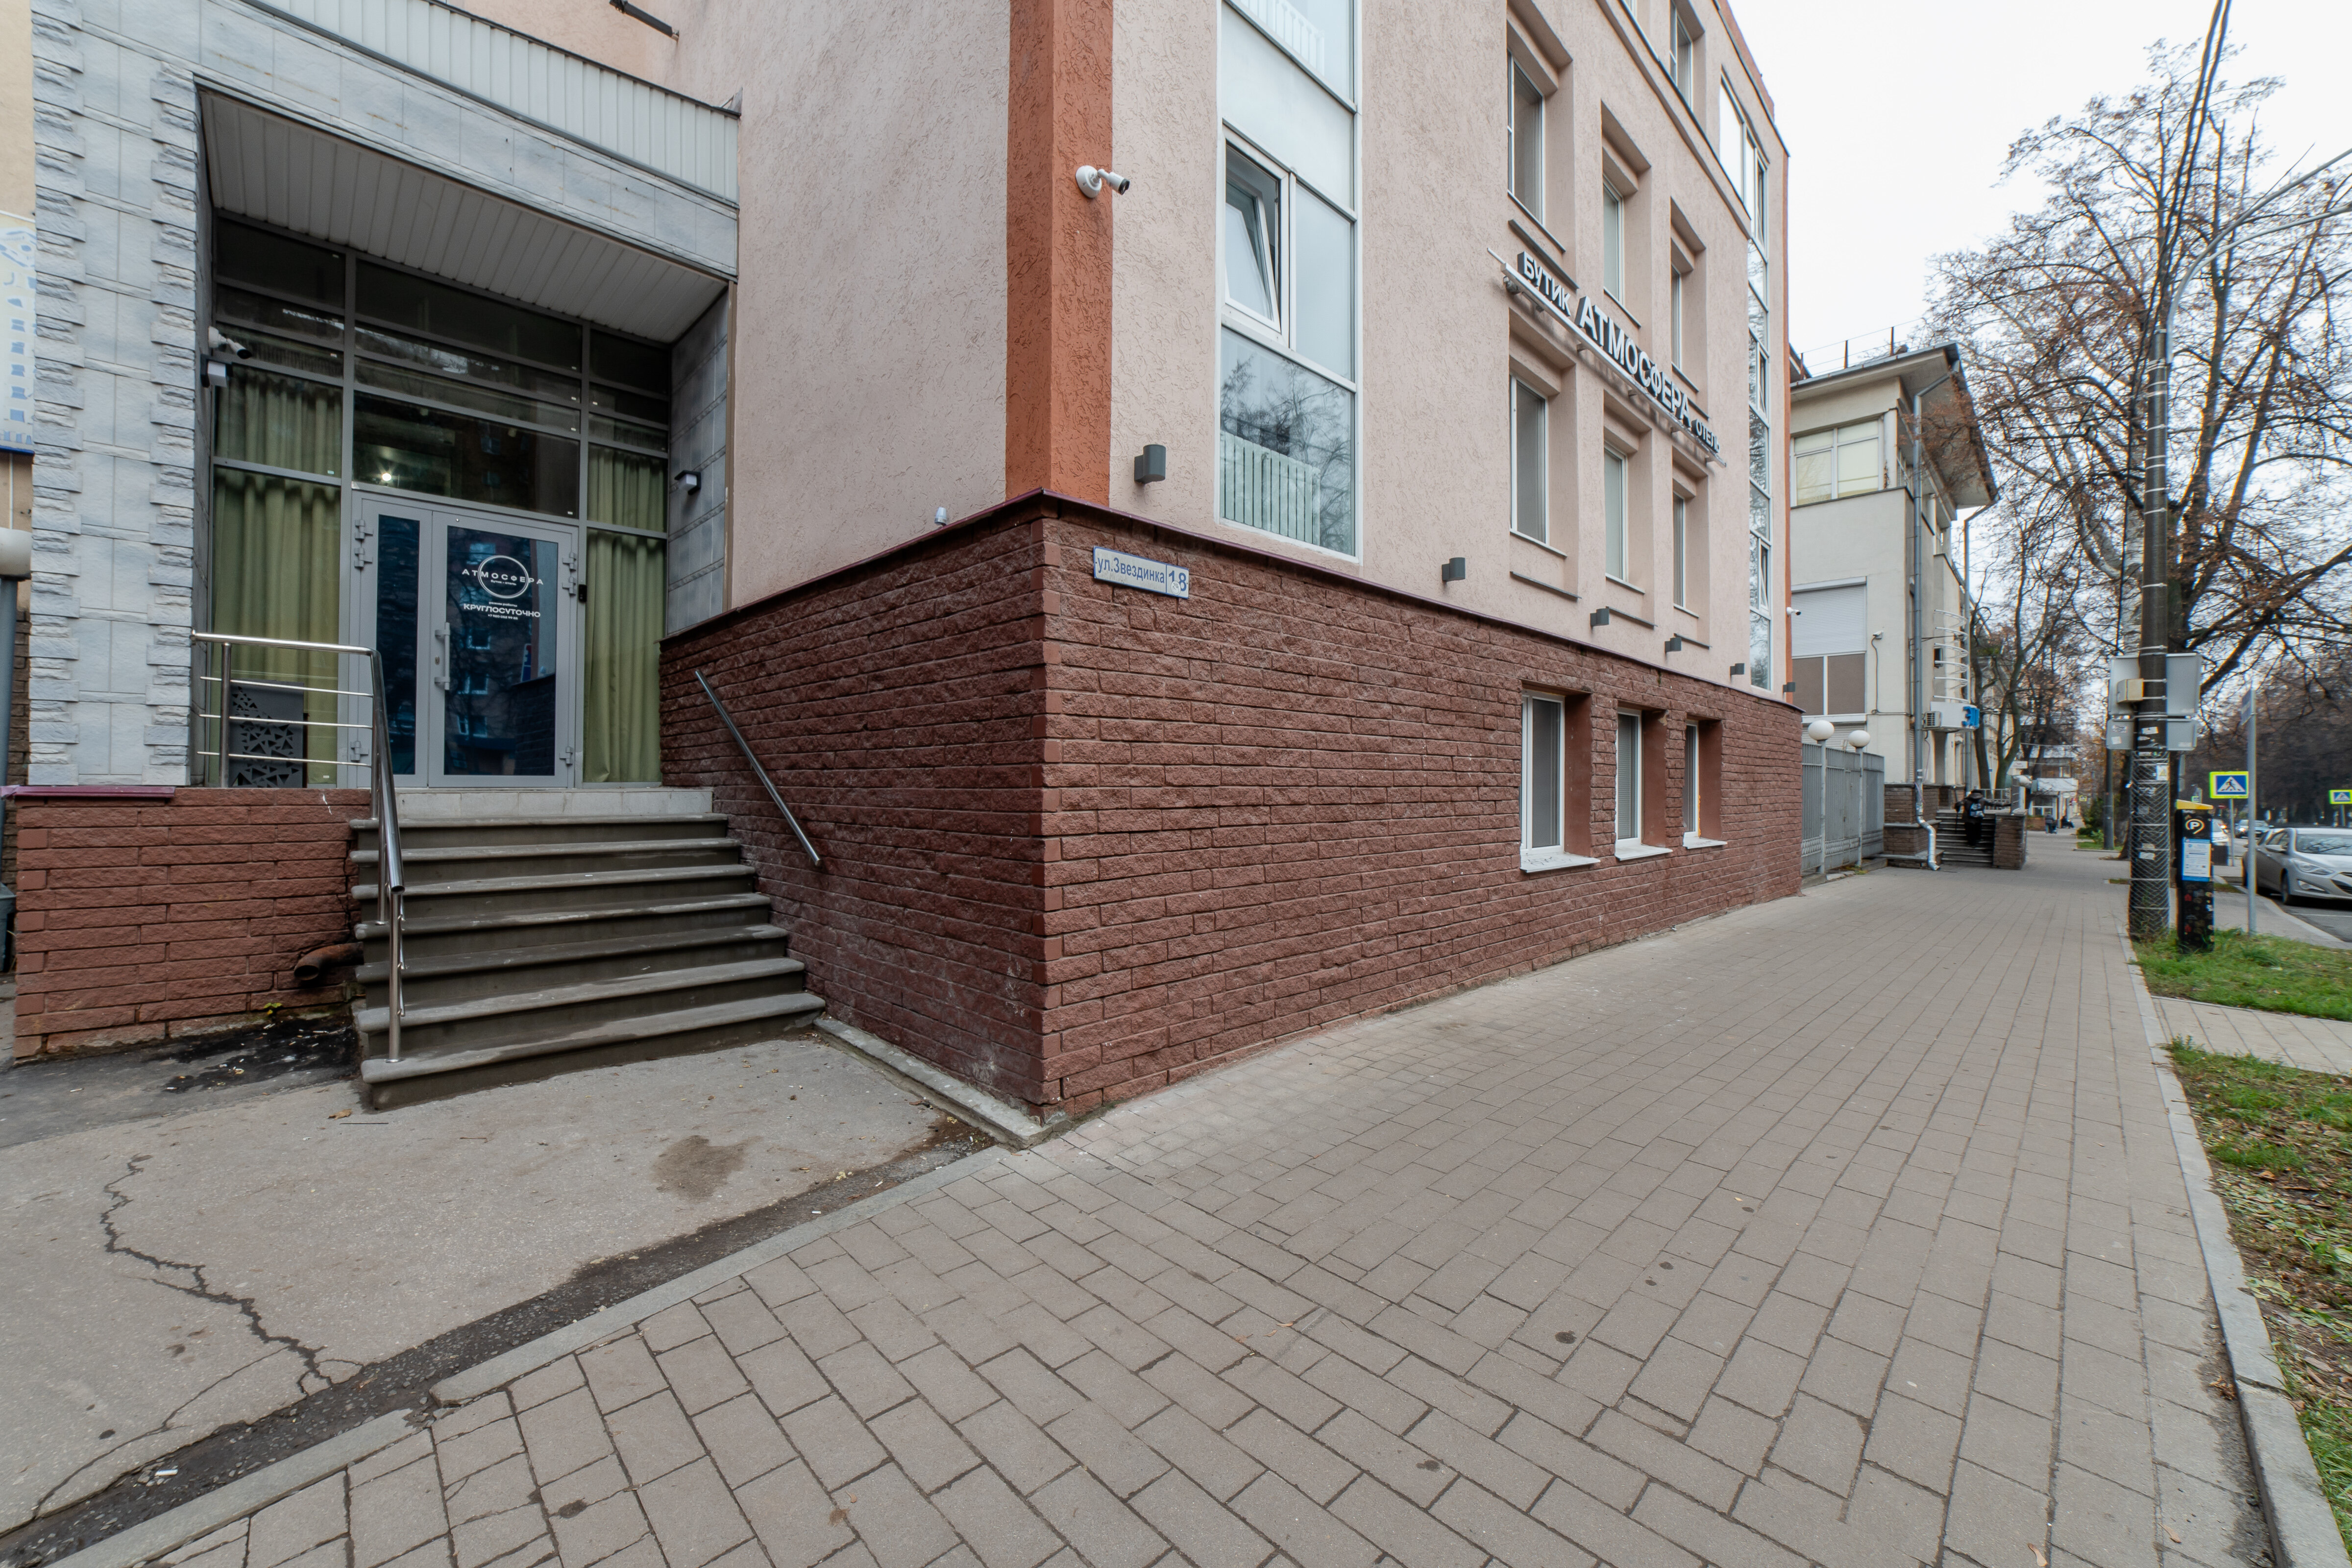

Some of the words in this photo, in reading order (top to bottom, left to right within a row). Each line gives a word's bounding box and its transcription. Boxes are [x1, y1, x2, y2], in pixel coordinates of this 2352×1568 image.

[1522, 251, 1571, 317] БУТИК
[1579, 295, 1691, 428] АТМОСФЕРА
[1695, 418, 1720, 453] ОТЕЛЬ
[462, 568, 544, 585] АТМОСФЕРА
[1168, 570, 1187, 592] 18
[463, 603, 541, 618] КРУГЛОСУТОЧНО
